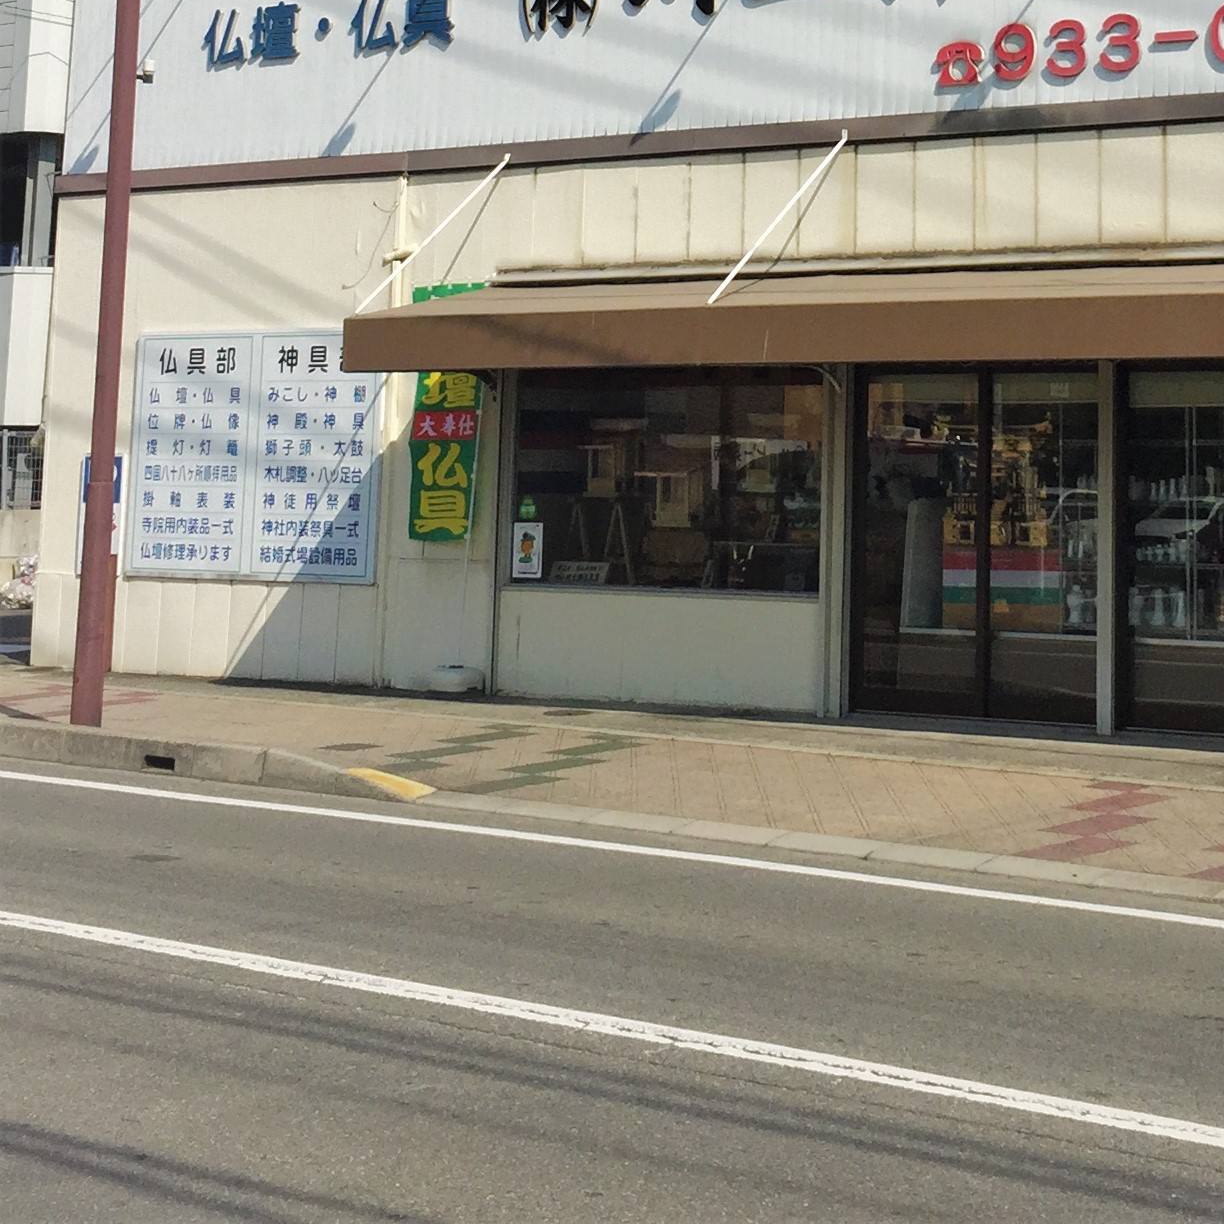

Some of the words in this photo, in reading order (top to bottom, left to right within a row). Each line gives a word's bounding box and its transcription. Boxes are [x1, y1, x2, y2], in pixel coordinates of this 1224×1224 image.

[159, 346, 237, 375] 仏具部
[278, 345, 345, 374] 神具
[413, 442, 469, 535] 仏具
[140, 542, 233, 561] 仏壇修理承ります
